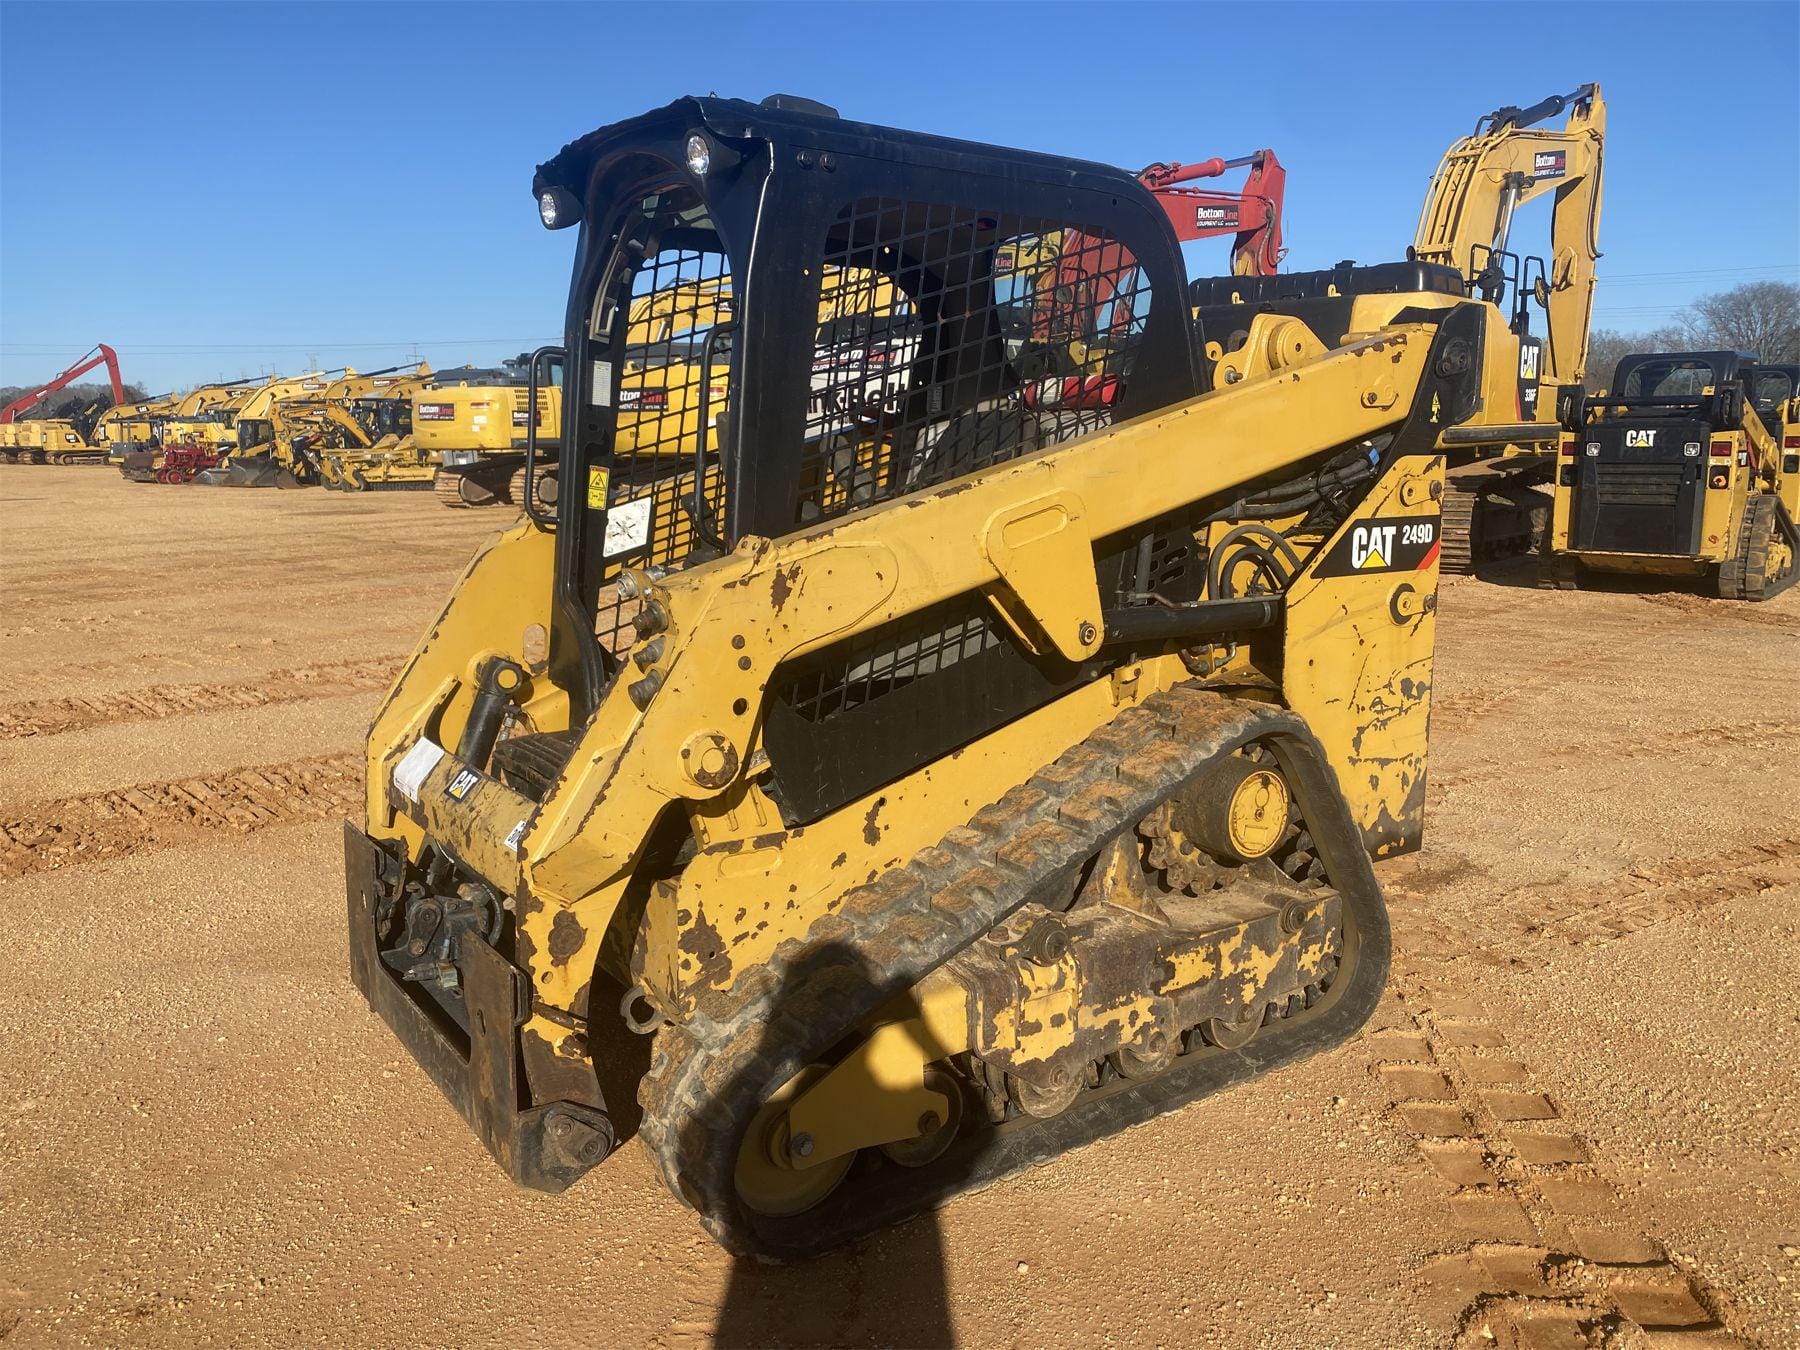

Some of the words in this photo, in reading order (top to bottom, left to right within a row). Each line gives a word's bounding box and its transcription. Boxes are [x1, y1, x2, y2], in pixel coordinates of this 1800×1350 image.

[1520, 344, 1539, 379] CAT
[1626, 429, 1657, 447] CAT
[1351, 526, 1397, 569] CAT
[1401, 523, 1433, 545] 249D
[448, 770, 479, 800] CAT
